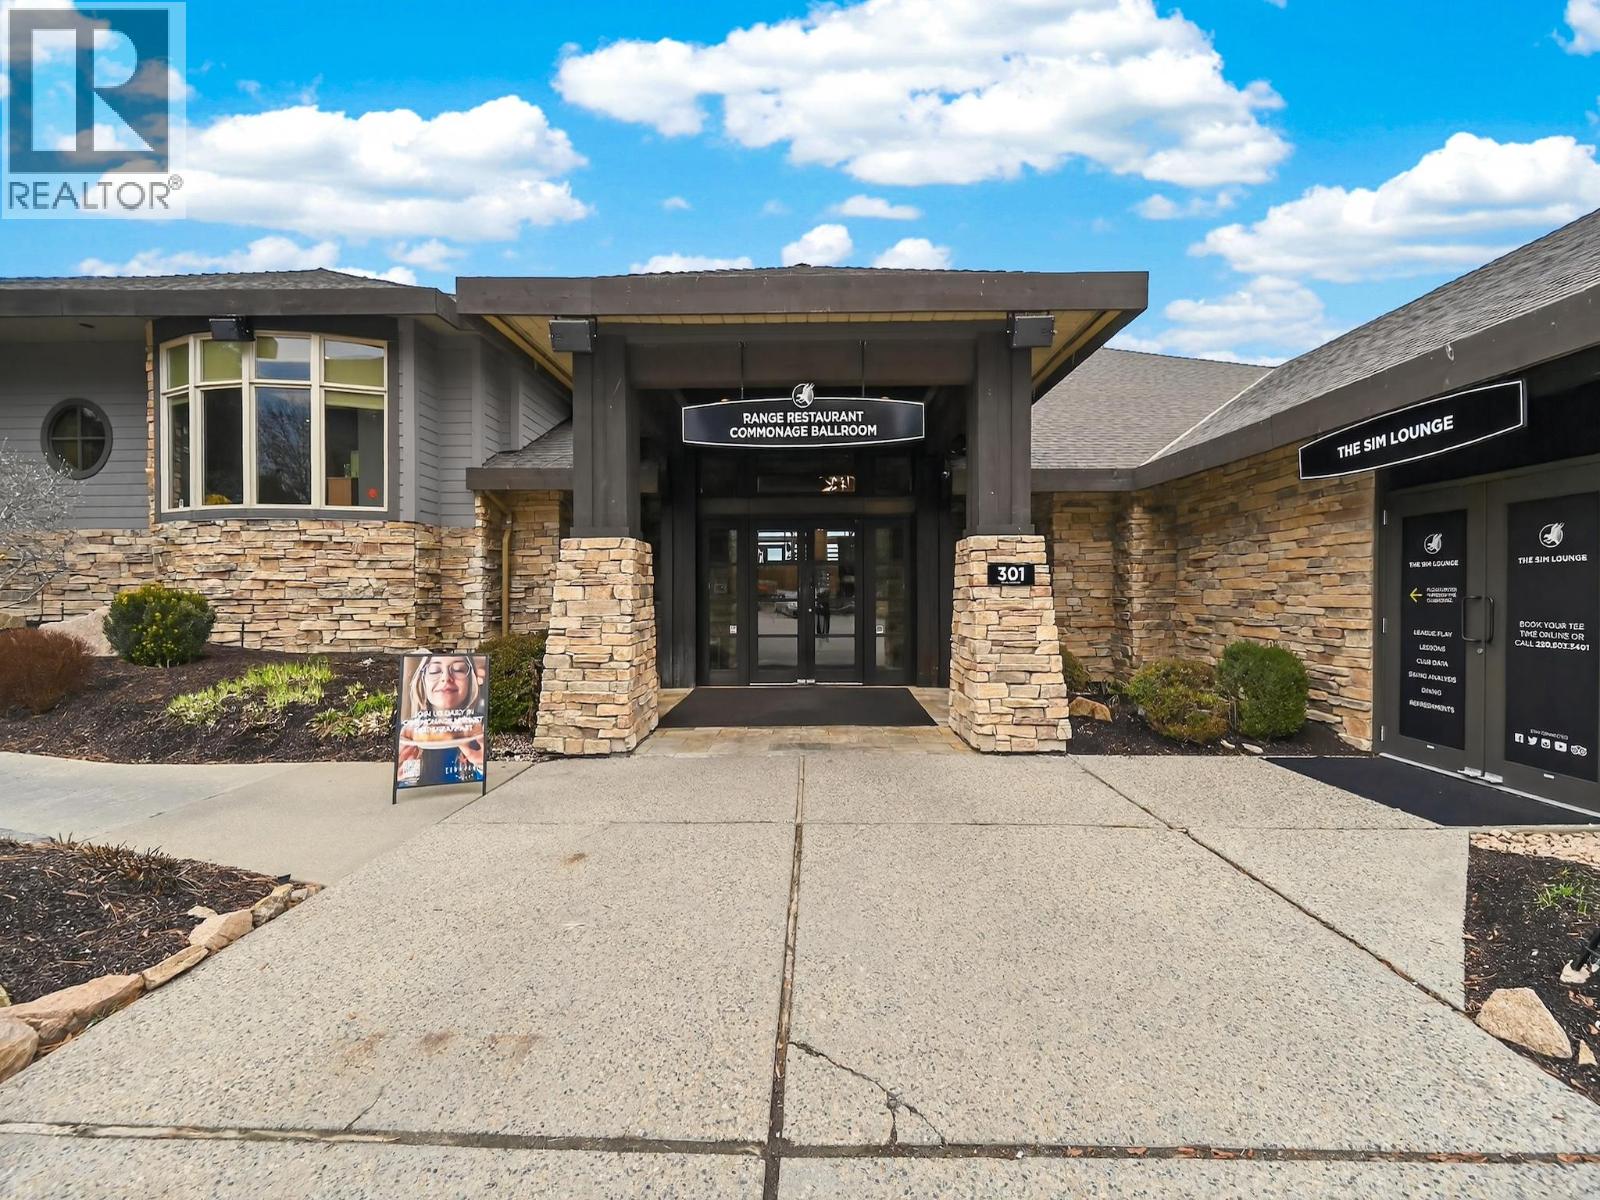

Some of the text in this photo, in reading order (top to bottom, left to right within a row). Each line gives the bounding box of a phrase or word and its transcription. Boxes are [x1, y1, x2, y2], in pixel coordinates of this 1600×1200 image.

[743, 411, 864, 425] RANGE RESTAURANT
[730, 424, 877, 438] COMMONAGE BALLROOM
[1337, 415, 1454, 459] THE SIM LOUNGE
[1518, 554, 1588, 564] THE SIM LOUNGE
[997, 566, 1025, 581] 301
[1519, 620, 1542, 629] BOOK
[1544, 621, 1567, 630] YOUR
[1520, 630, 1585, 641] TIME ONLINE OR
[1514, 639, 1534, 648] CALL
